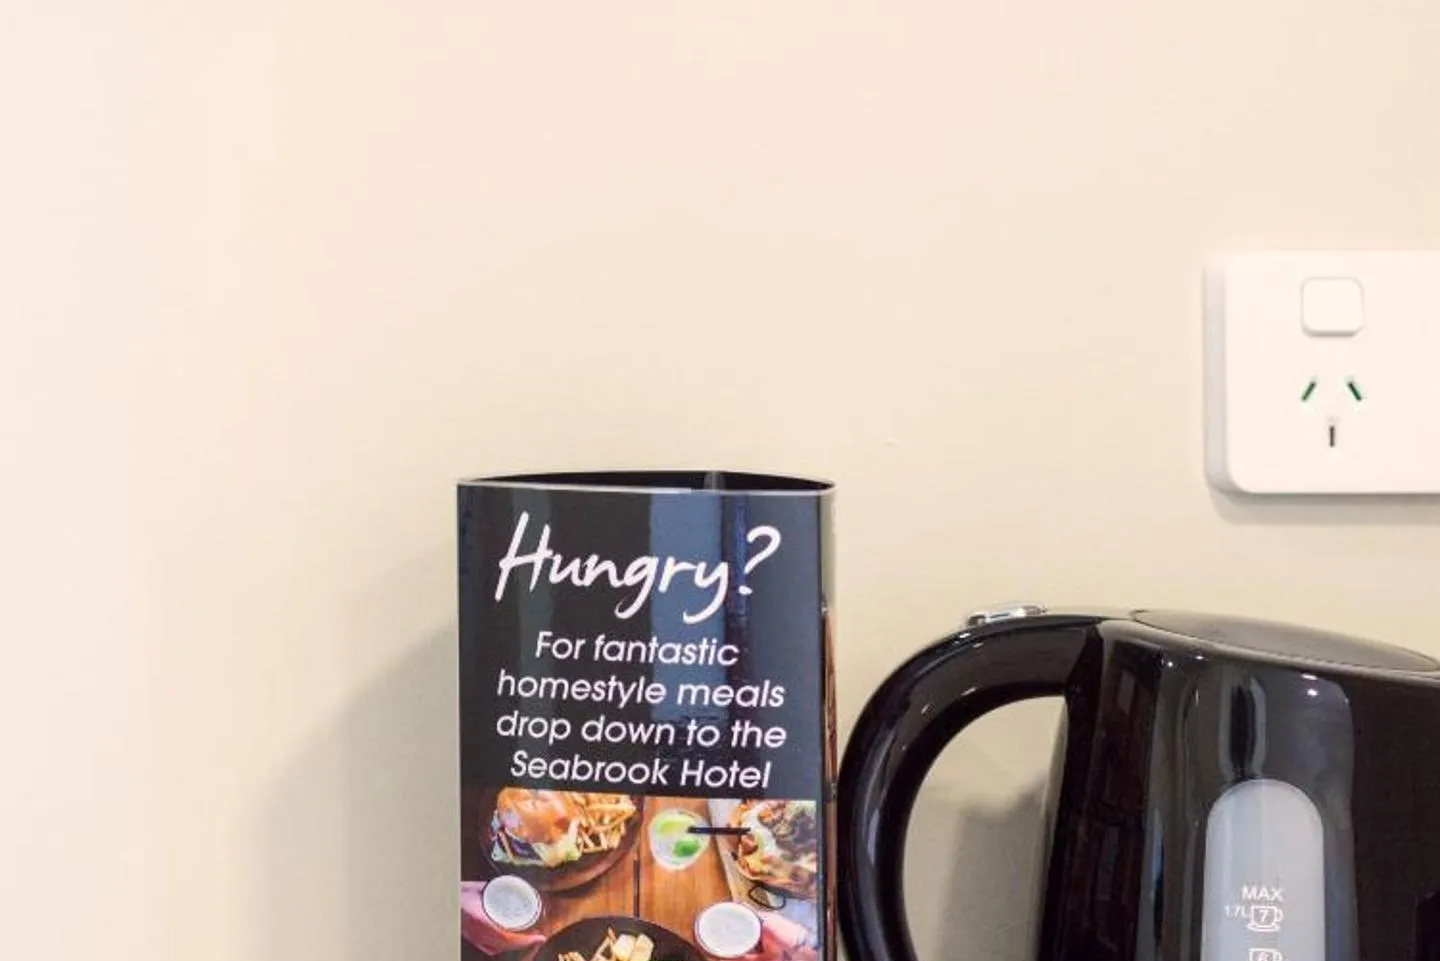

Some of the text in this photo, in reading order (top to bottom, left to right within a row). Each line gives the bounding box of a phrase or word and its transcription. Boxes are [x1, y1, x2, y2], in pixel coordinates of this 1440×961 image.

[495, 511, 781, 624] Hungry?
[535, 631, 739, 666] For fantastic
[497, 669, 785, 708] homestyle meals
[496, 711, 787, 748] drop down to the
[510, 750, 771, 788] Seabrook Hotel
[1242, 885, 1283, 901] MAX
